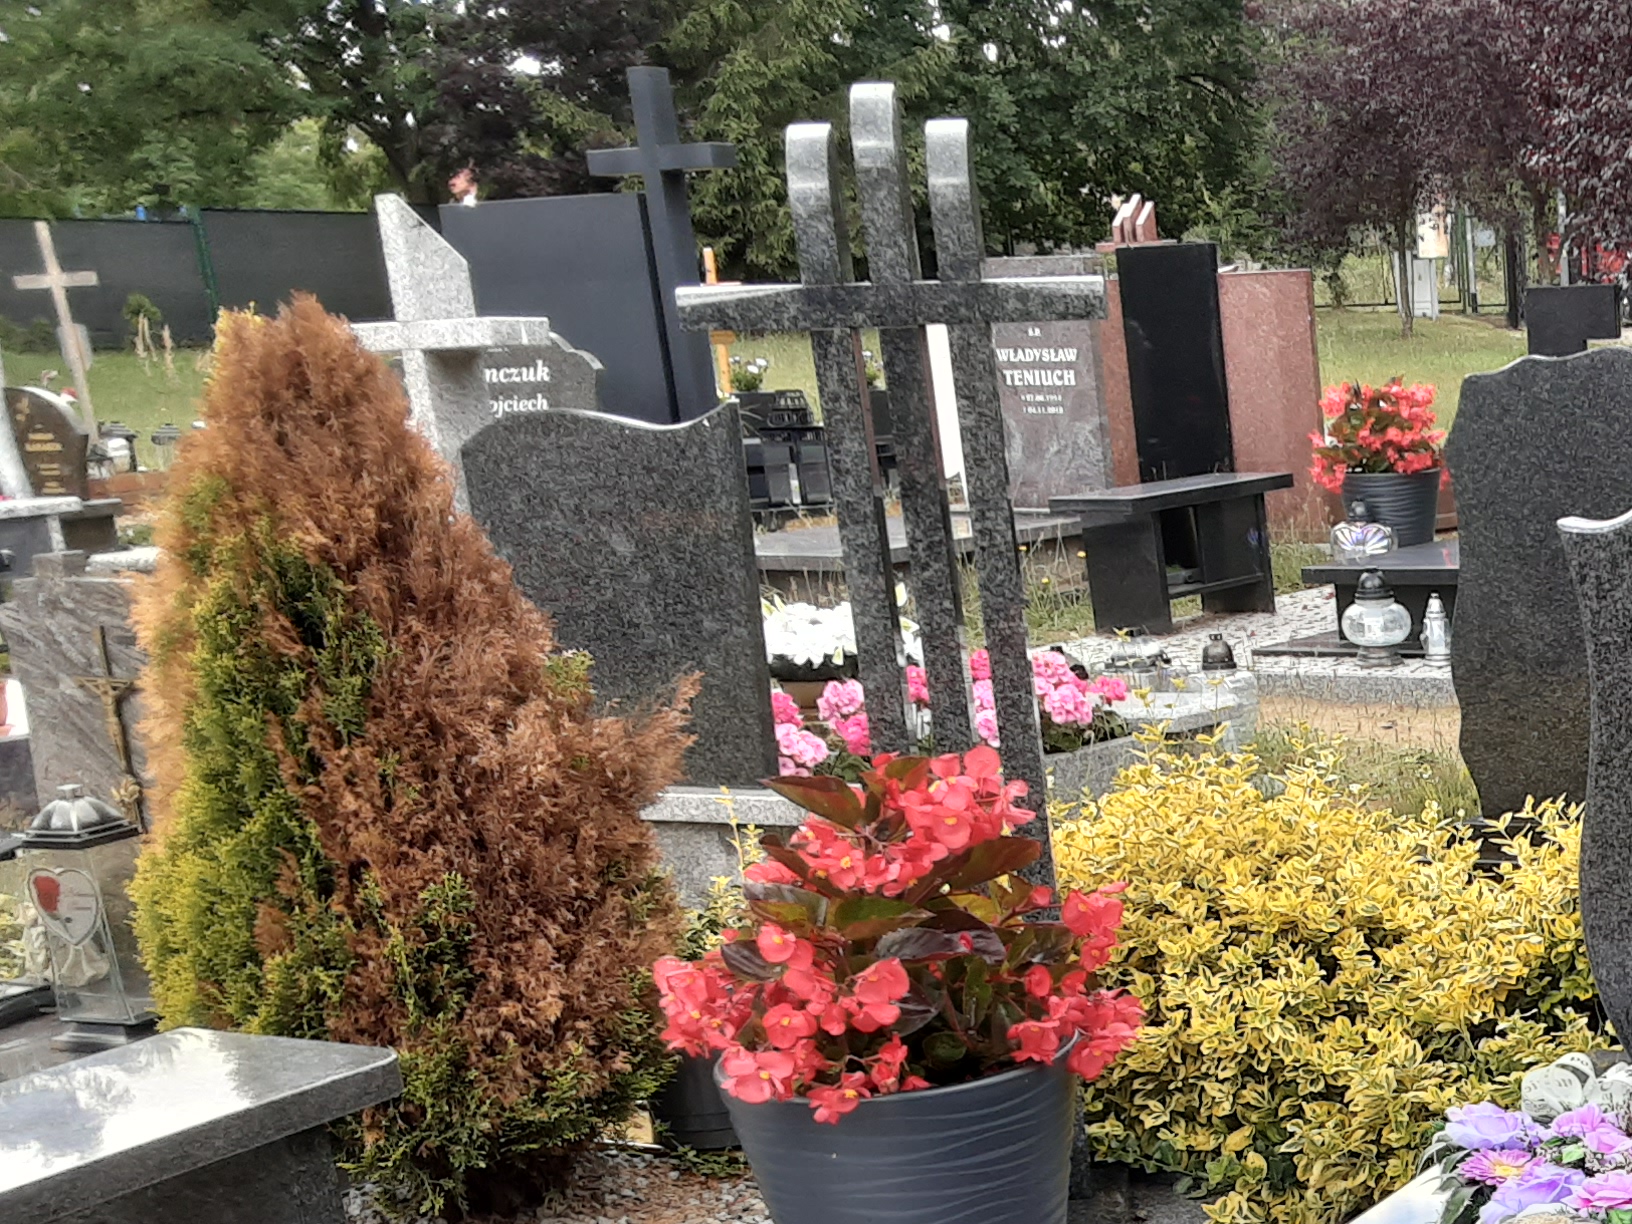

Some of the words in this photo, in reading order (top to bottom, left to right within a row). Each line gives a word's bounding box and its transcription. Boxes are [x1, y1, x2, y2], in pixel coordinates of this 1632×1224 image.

[995, 347, 1078, 363] WŁADYSŁAW
[484, 359, 550, 383] nczuk
[1002, 369, 1077, 386] TENIUCH
[489, 393, 549, 418] ojciech
